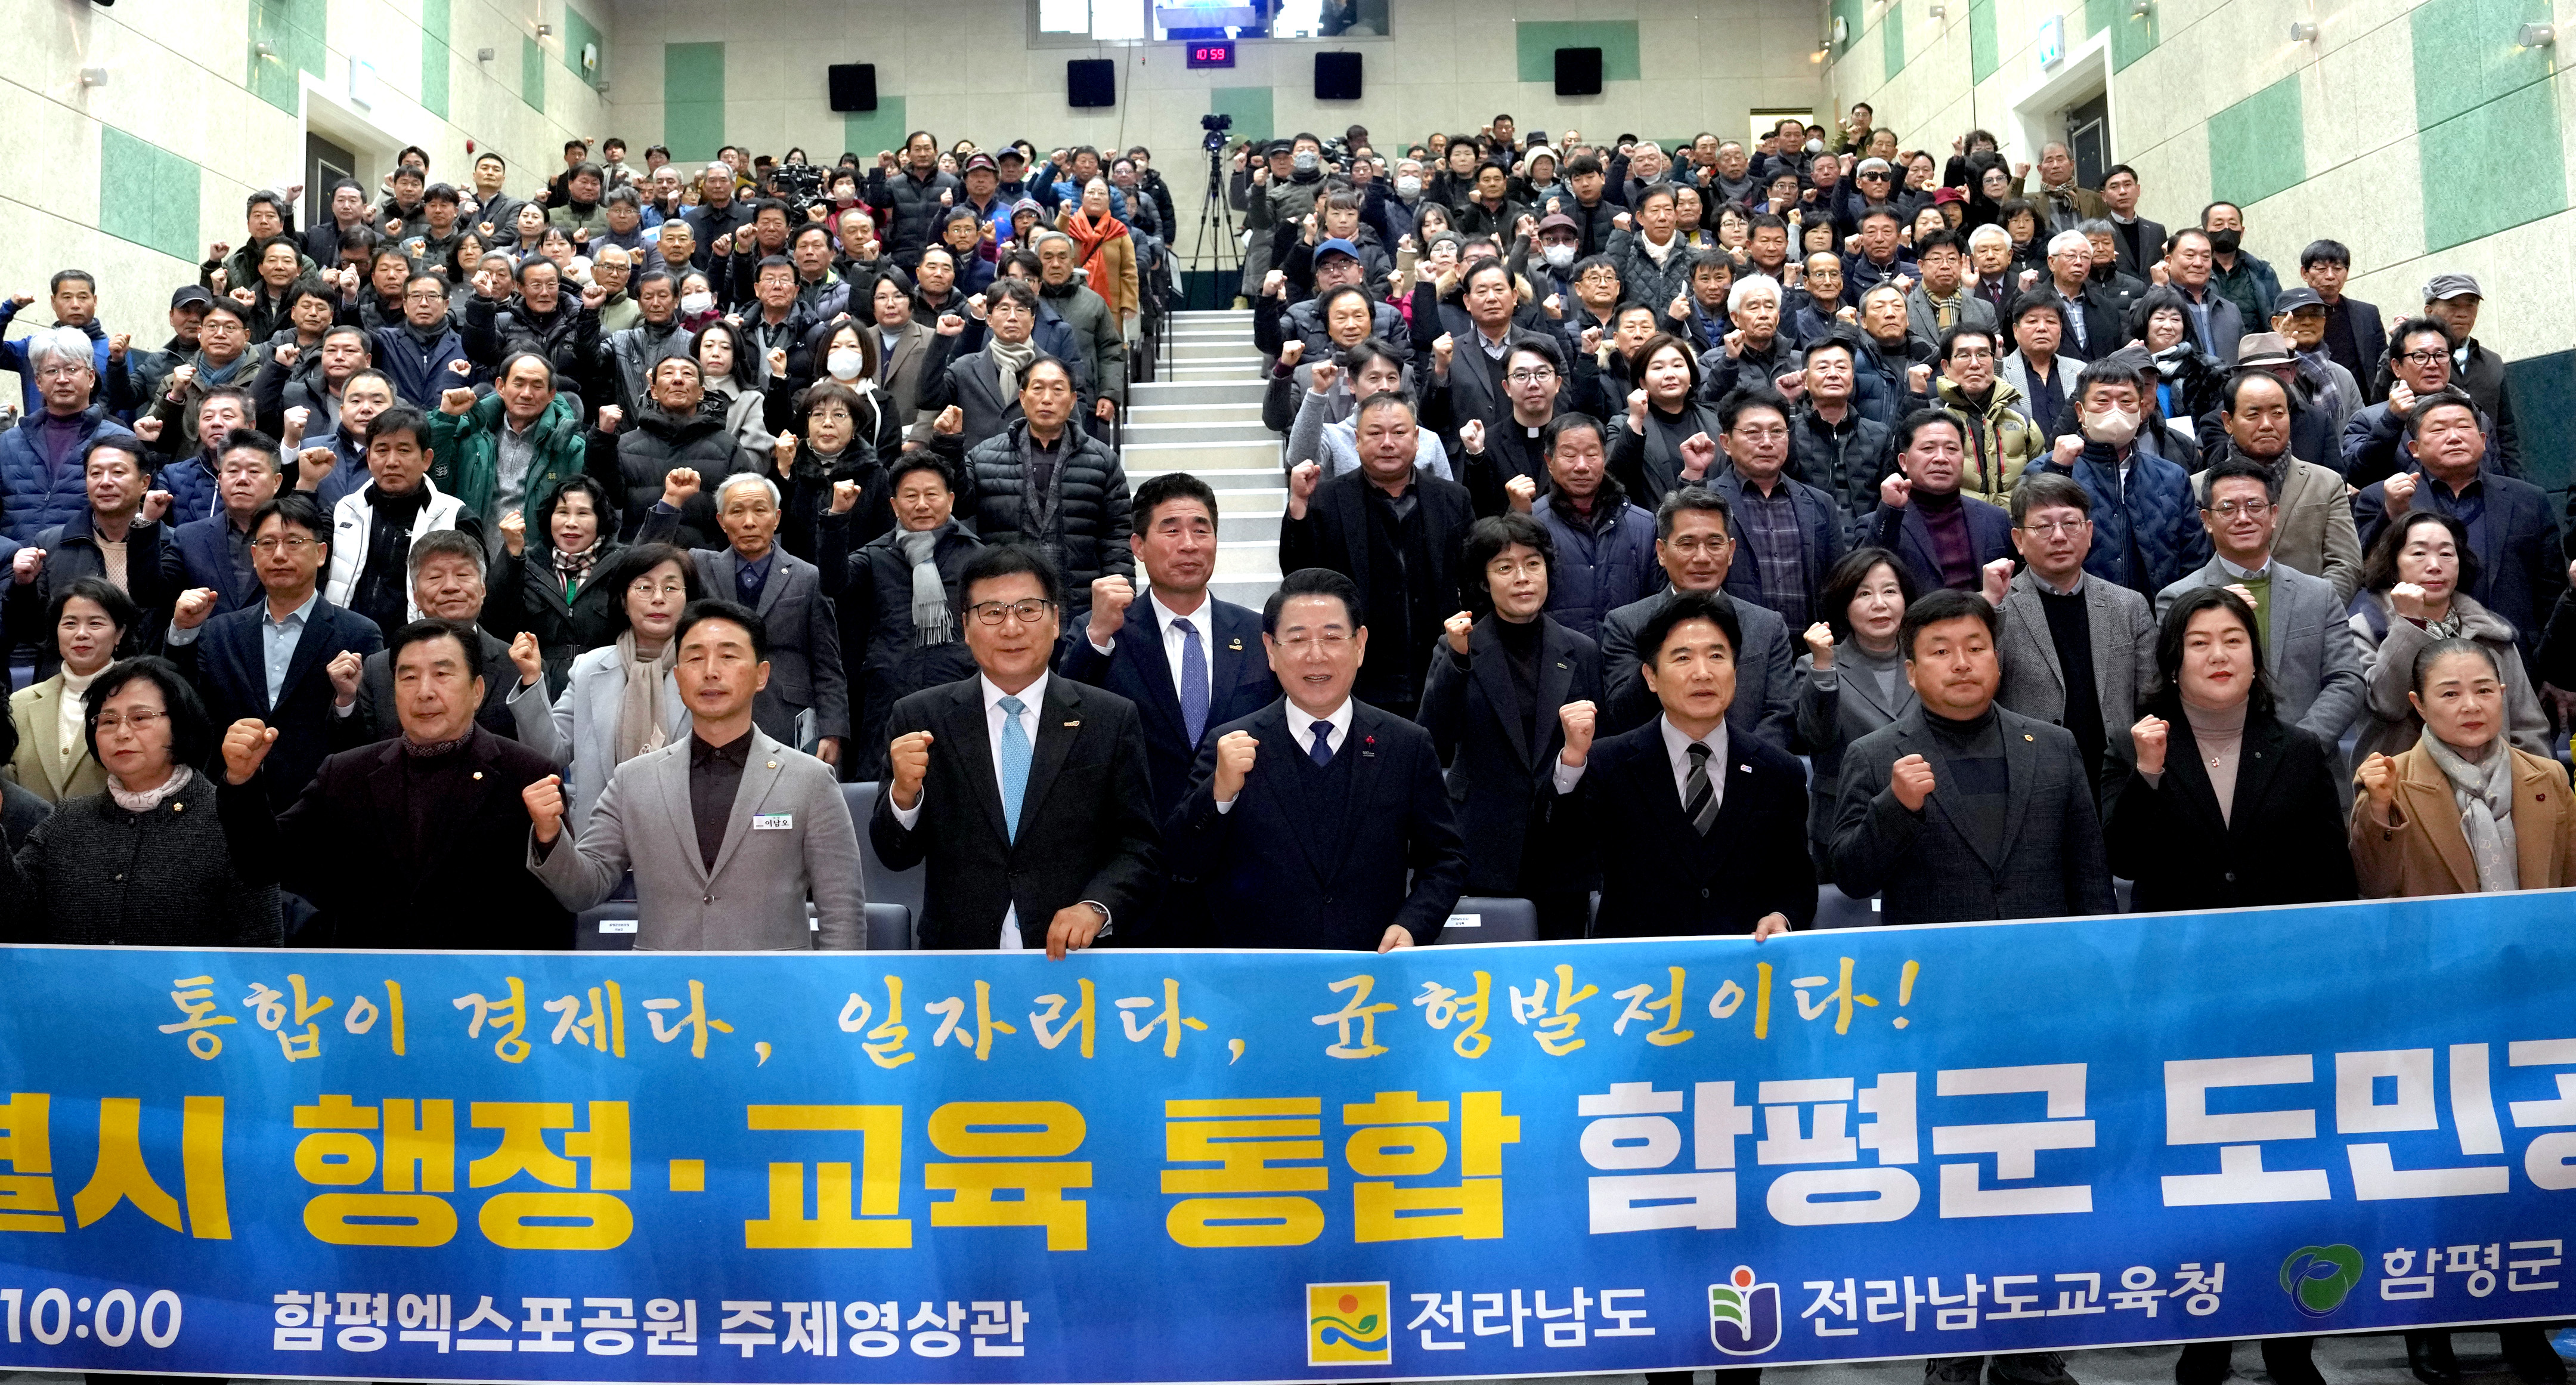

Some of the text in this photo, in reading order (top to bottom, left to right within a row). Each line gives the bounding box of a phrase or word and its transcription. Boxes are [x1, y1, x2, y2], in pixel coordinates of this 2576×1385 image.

[159, 957, 1919, 1069] 통합이 경제다, 일자리다, 균형발전이다!
[1160, 1091, 1521, 1248] 통합
[1578, 1063, 2095, 1234] 함평군
[1801, 1263, 2224, 1337] 전라남도교육청
[2381, 1239, 2562, 1300] 함평군
[0, 1288, 182, 1348] 10:00
[274, 1290, 1029, 1358] 함평엑스포공원 주제영상관
[1407, 1287, 1655, 1350] 전라남도
